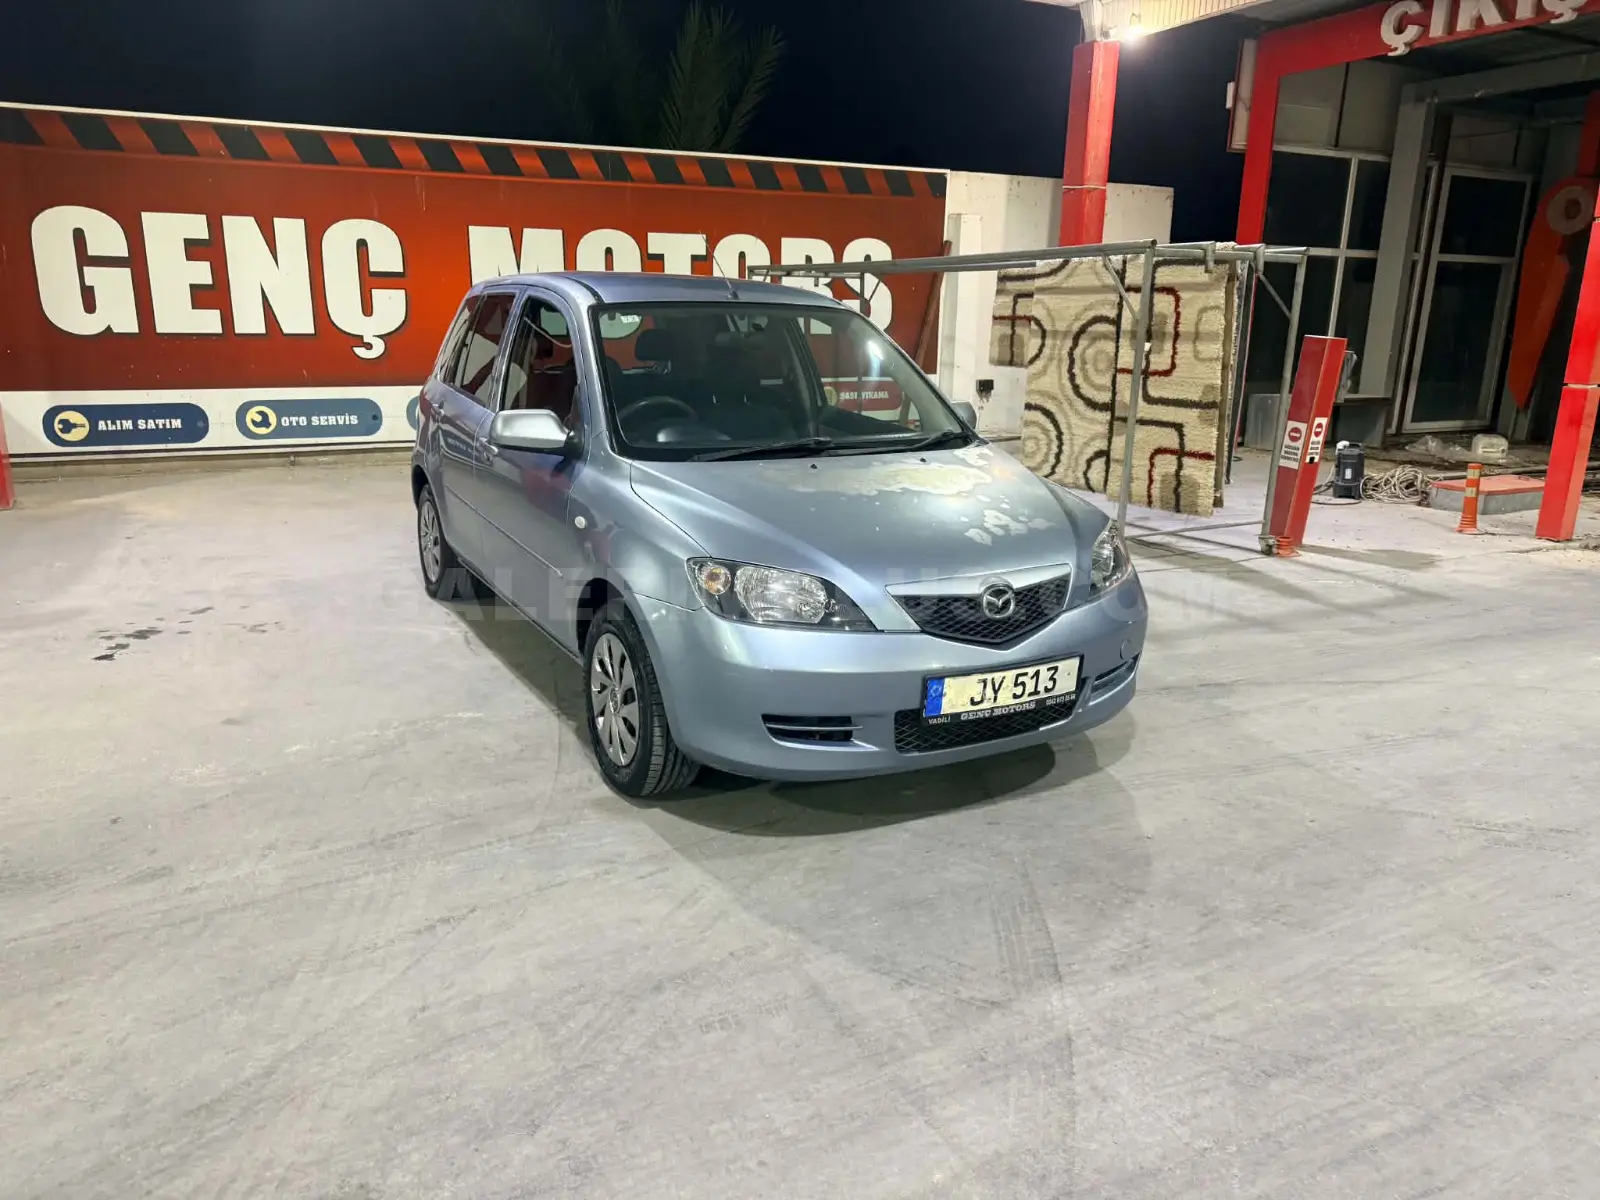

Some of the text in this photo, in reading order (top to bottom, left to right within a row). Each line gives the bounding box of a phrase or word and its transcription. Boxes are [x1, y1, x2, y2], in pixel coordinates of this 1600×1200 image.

[31, 205, 408, 360] GENÇ
[98, 419, 133, 431] ALIM
[281, 412, 359, 427] OTO SERVİS
[969, 665, 1059, 706] JY 513
[992, 701, 1036, 717] MOTORS
